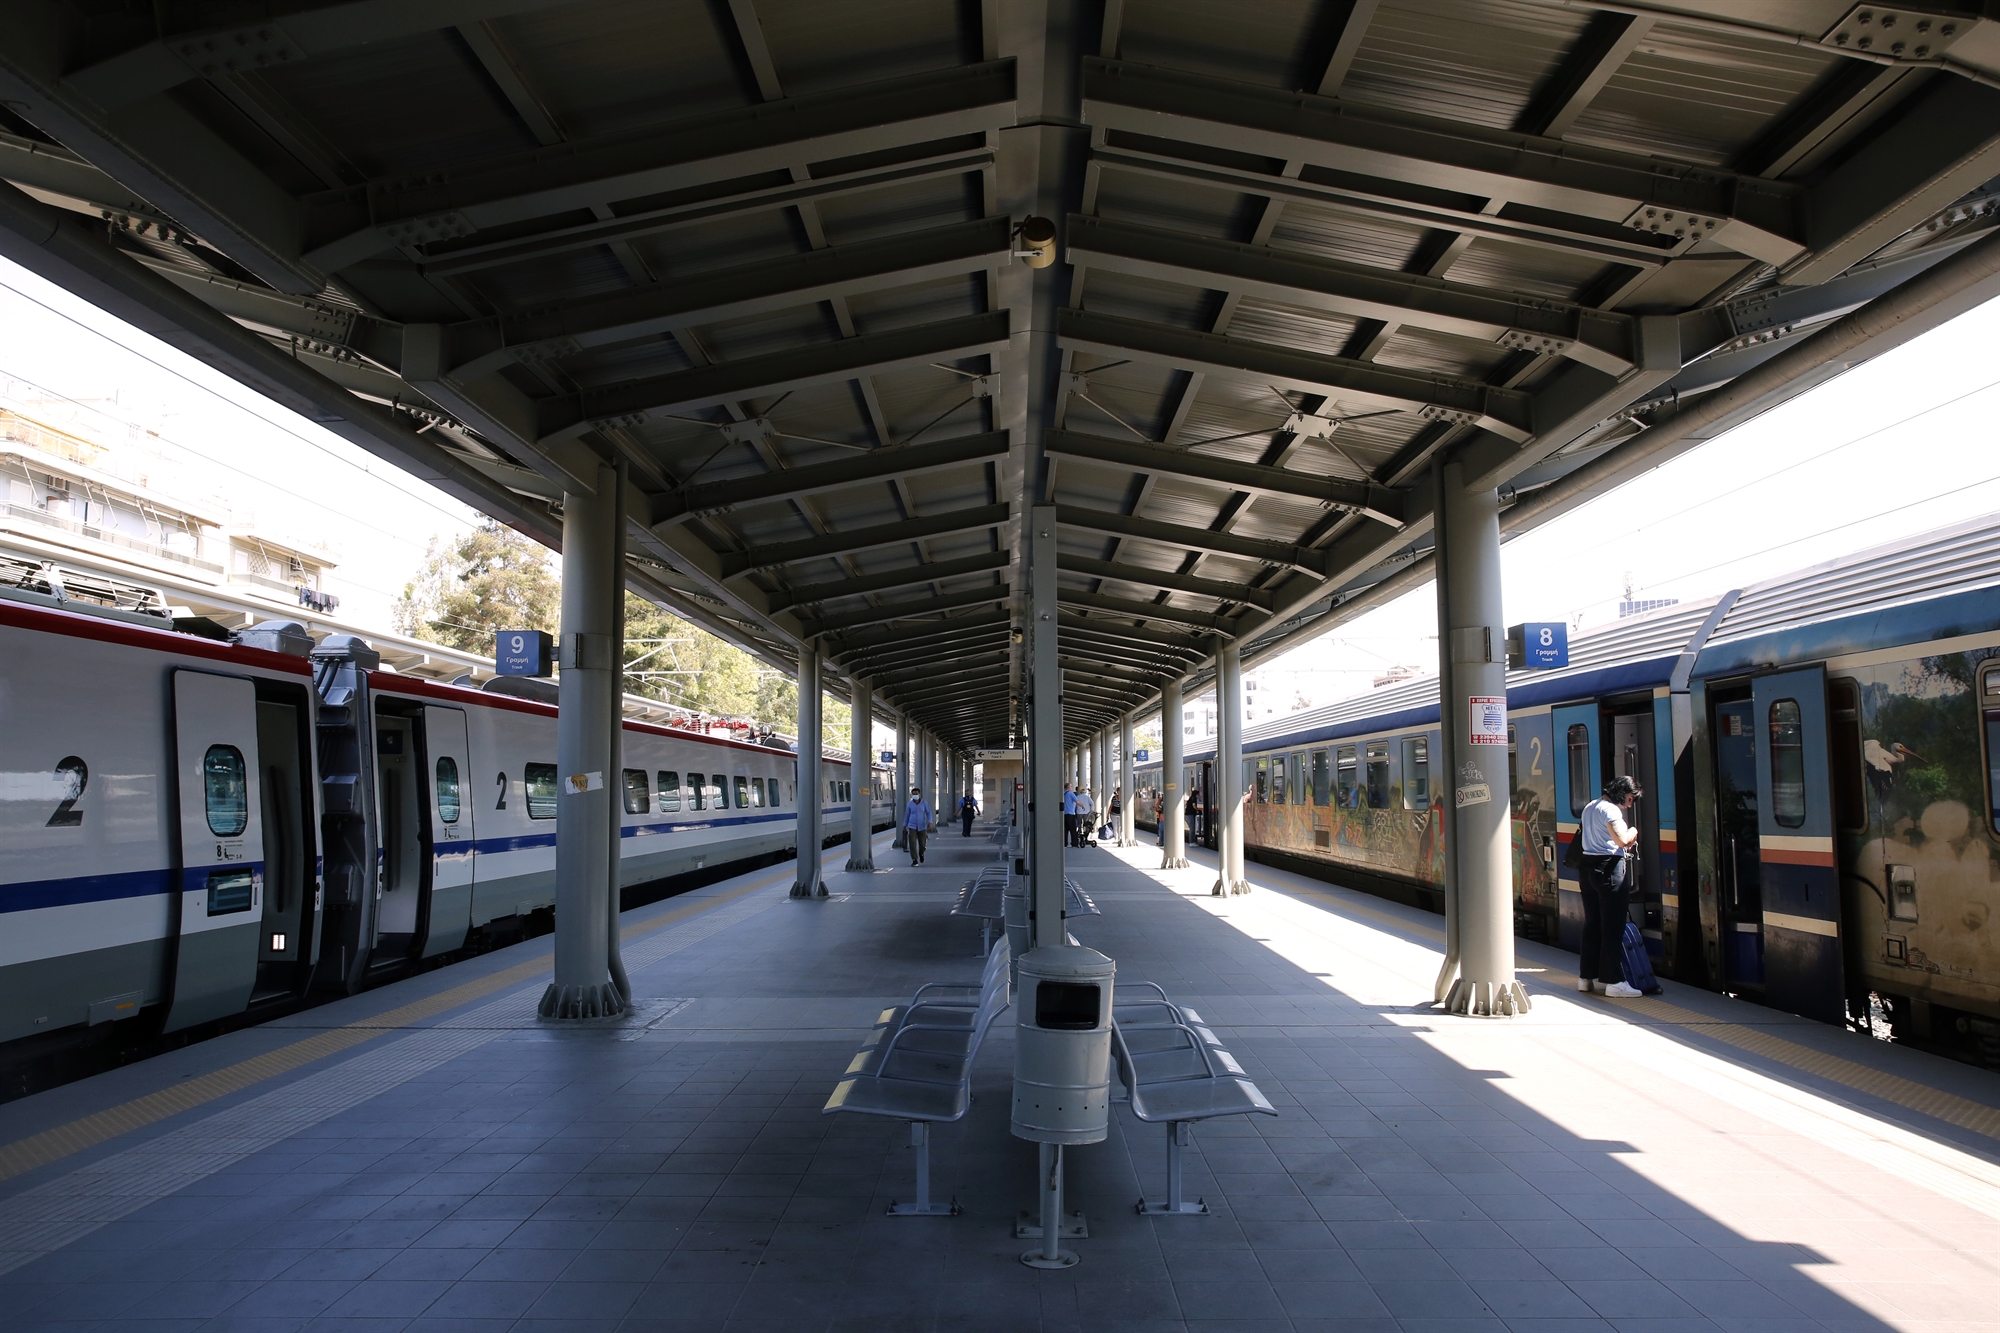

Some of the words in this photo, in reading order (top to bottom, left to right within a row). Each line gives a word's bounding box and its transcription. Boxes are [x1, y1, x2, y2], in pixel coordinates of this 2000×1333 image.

[511, 635, 524, 654] 9
[1540, 627, 1553, 646] 8
[506, 656, 529, 664] Γραμμή
[1530, 737, 1542, 775] 2
[45, 755, 88, 827] 2
[496, 771, 507, 810] 2
[216, 844, 222, 858] 8
